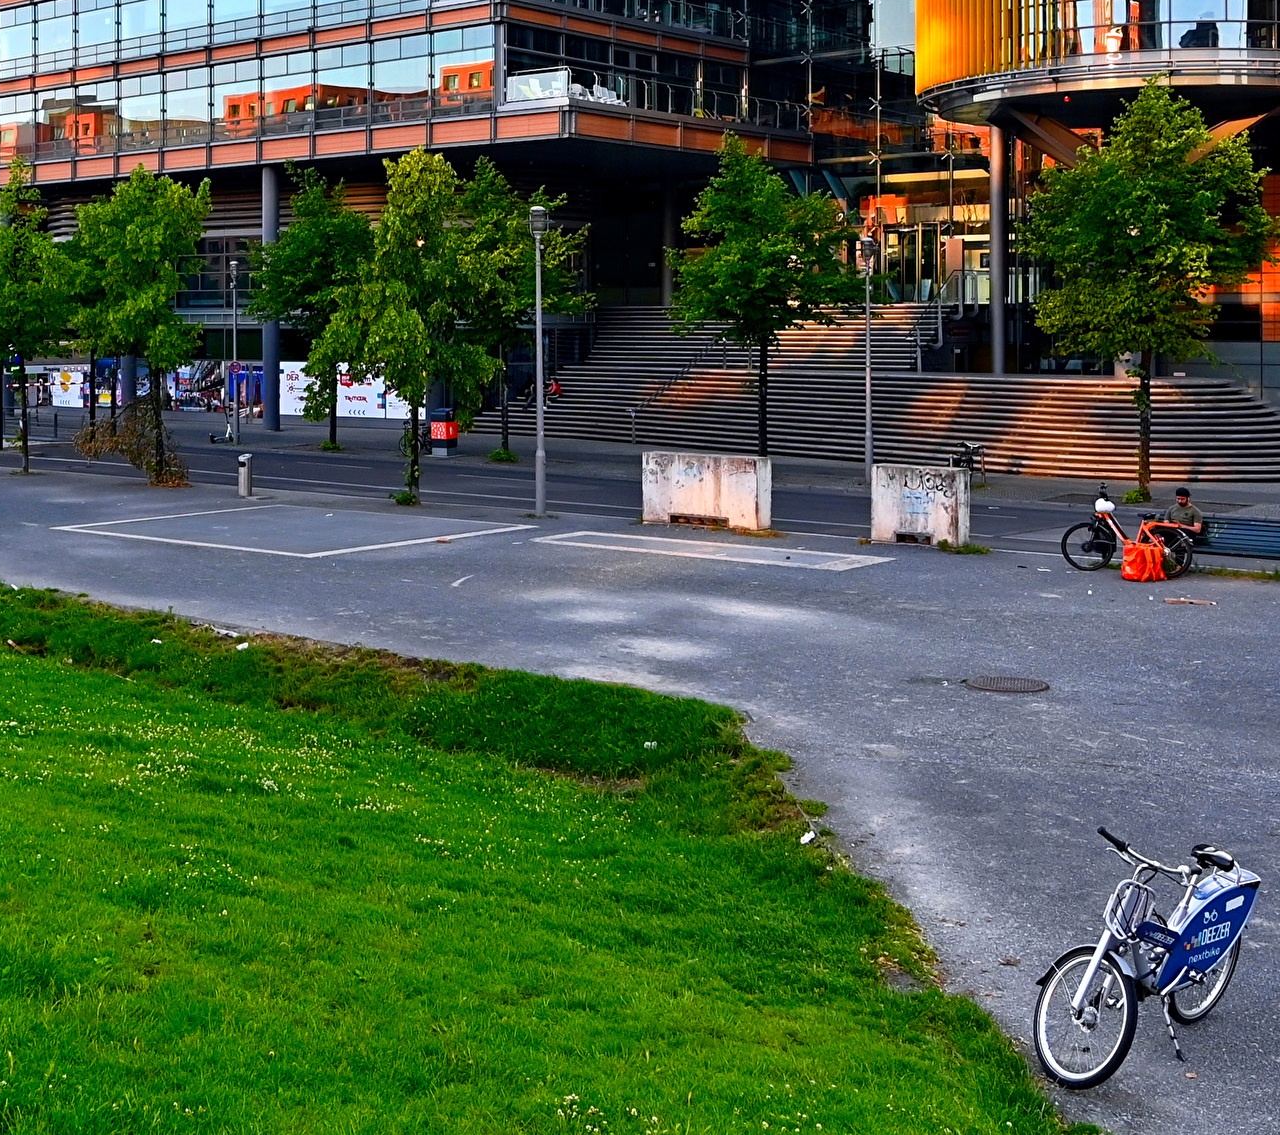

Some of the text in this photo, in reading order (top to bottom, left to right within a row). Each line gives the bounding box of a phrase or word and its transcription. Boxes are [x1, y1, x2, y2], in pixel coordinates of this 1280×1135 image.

[286, 373, 299, 381] DER
[1154, 931, 1175, 945] DEEZER
[1201, 921, 1231, 946] DEEZER
[1188, 947, 1221, 964] nextbike
